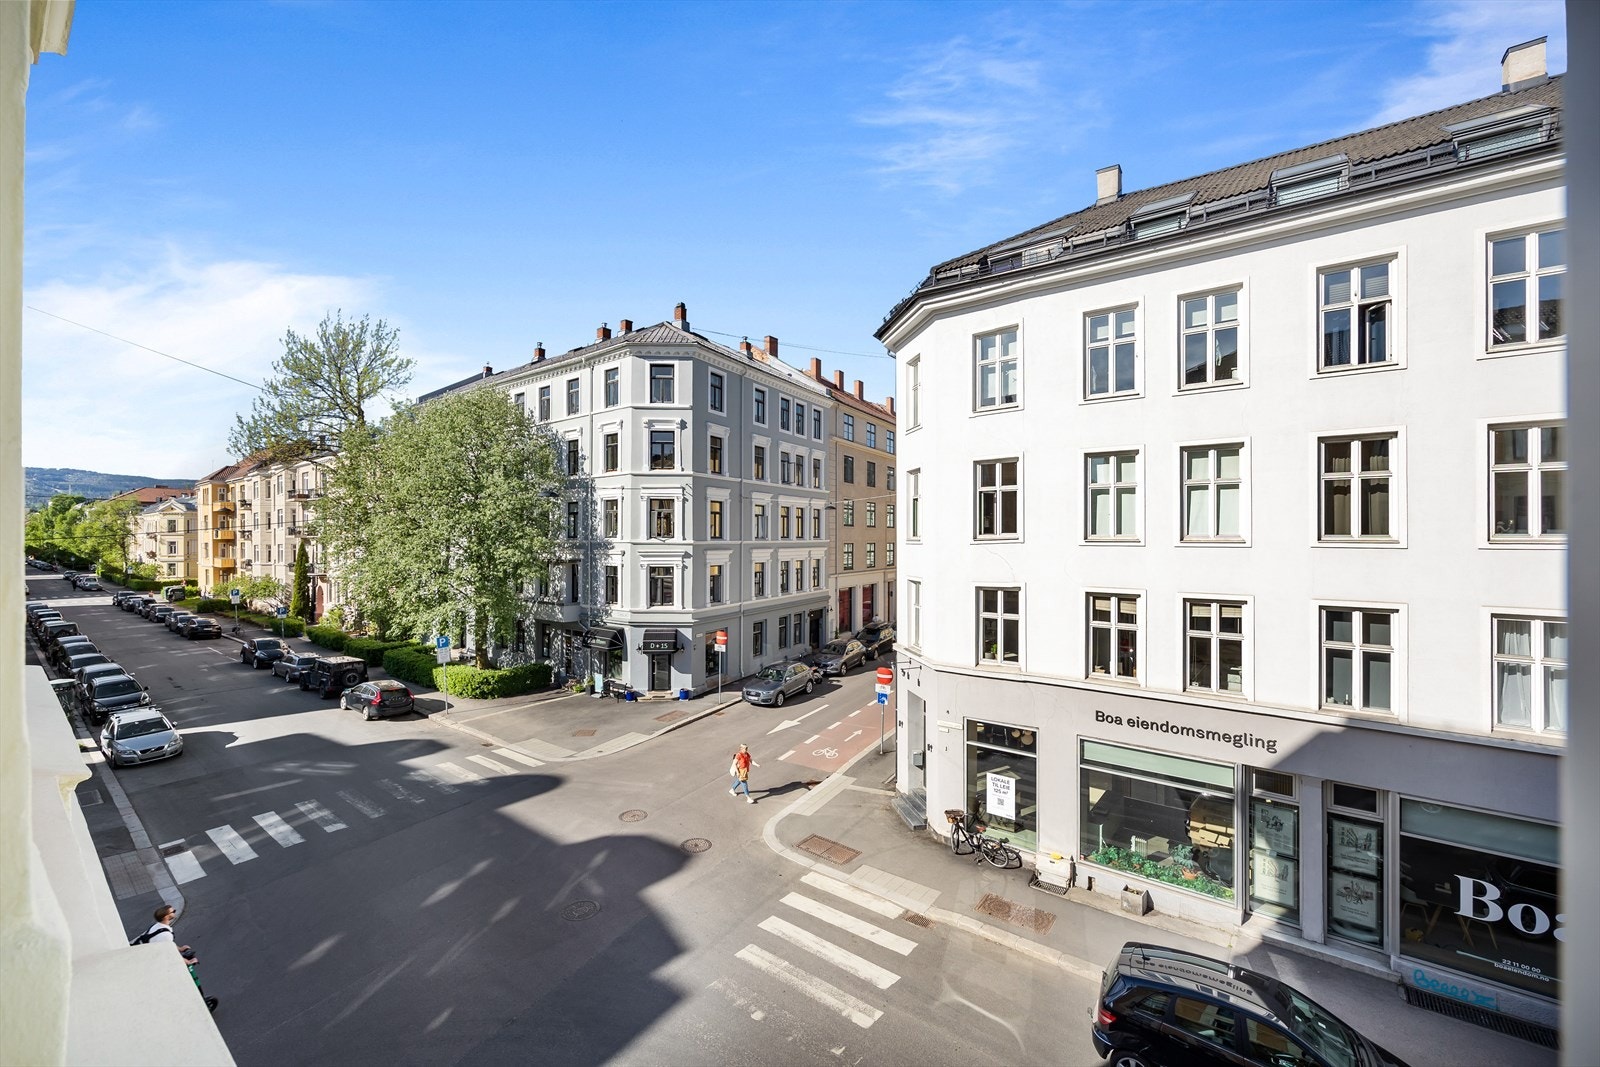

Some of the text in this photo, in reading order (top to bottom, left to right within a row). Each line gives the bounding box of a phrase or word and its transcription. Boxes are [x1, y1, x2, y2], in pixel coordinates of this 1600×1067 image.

[1095, 710, 1278, 754] Boa eiendomsmegling
[991, 777, 1010, 785] LOKALE
[992, 781, 1000, 789] TIL
